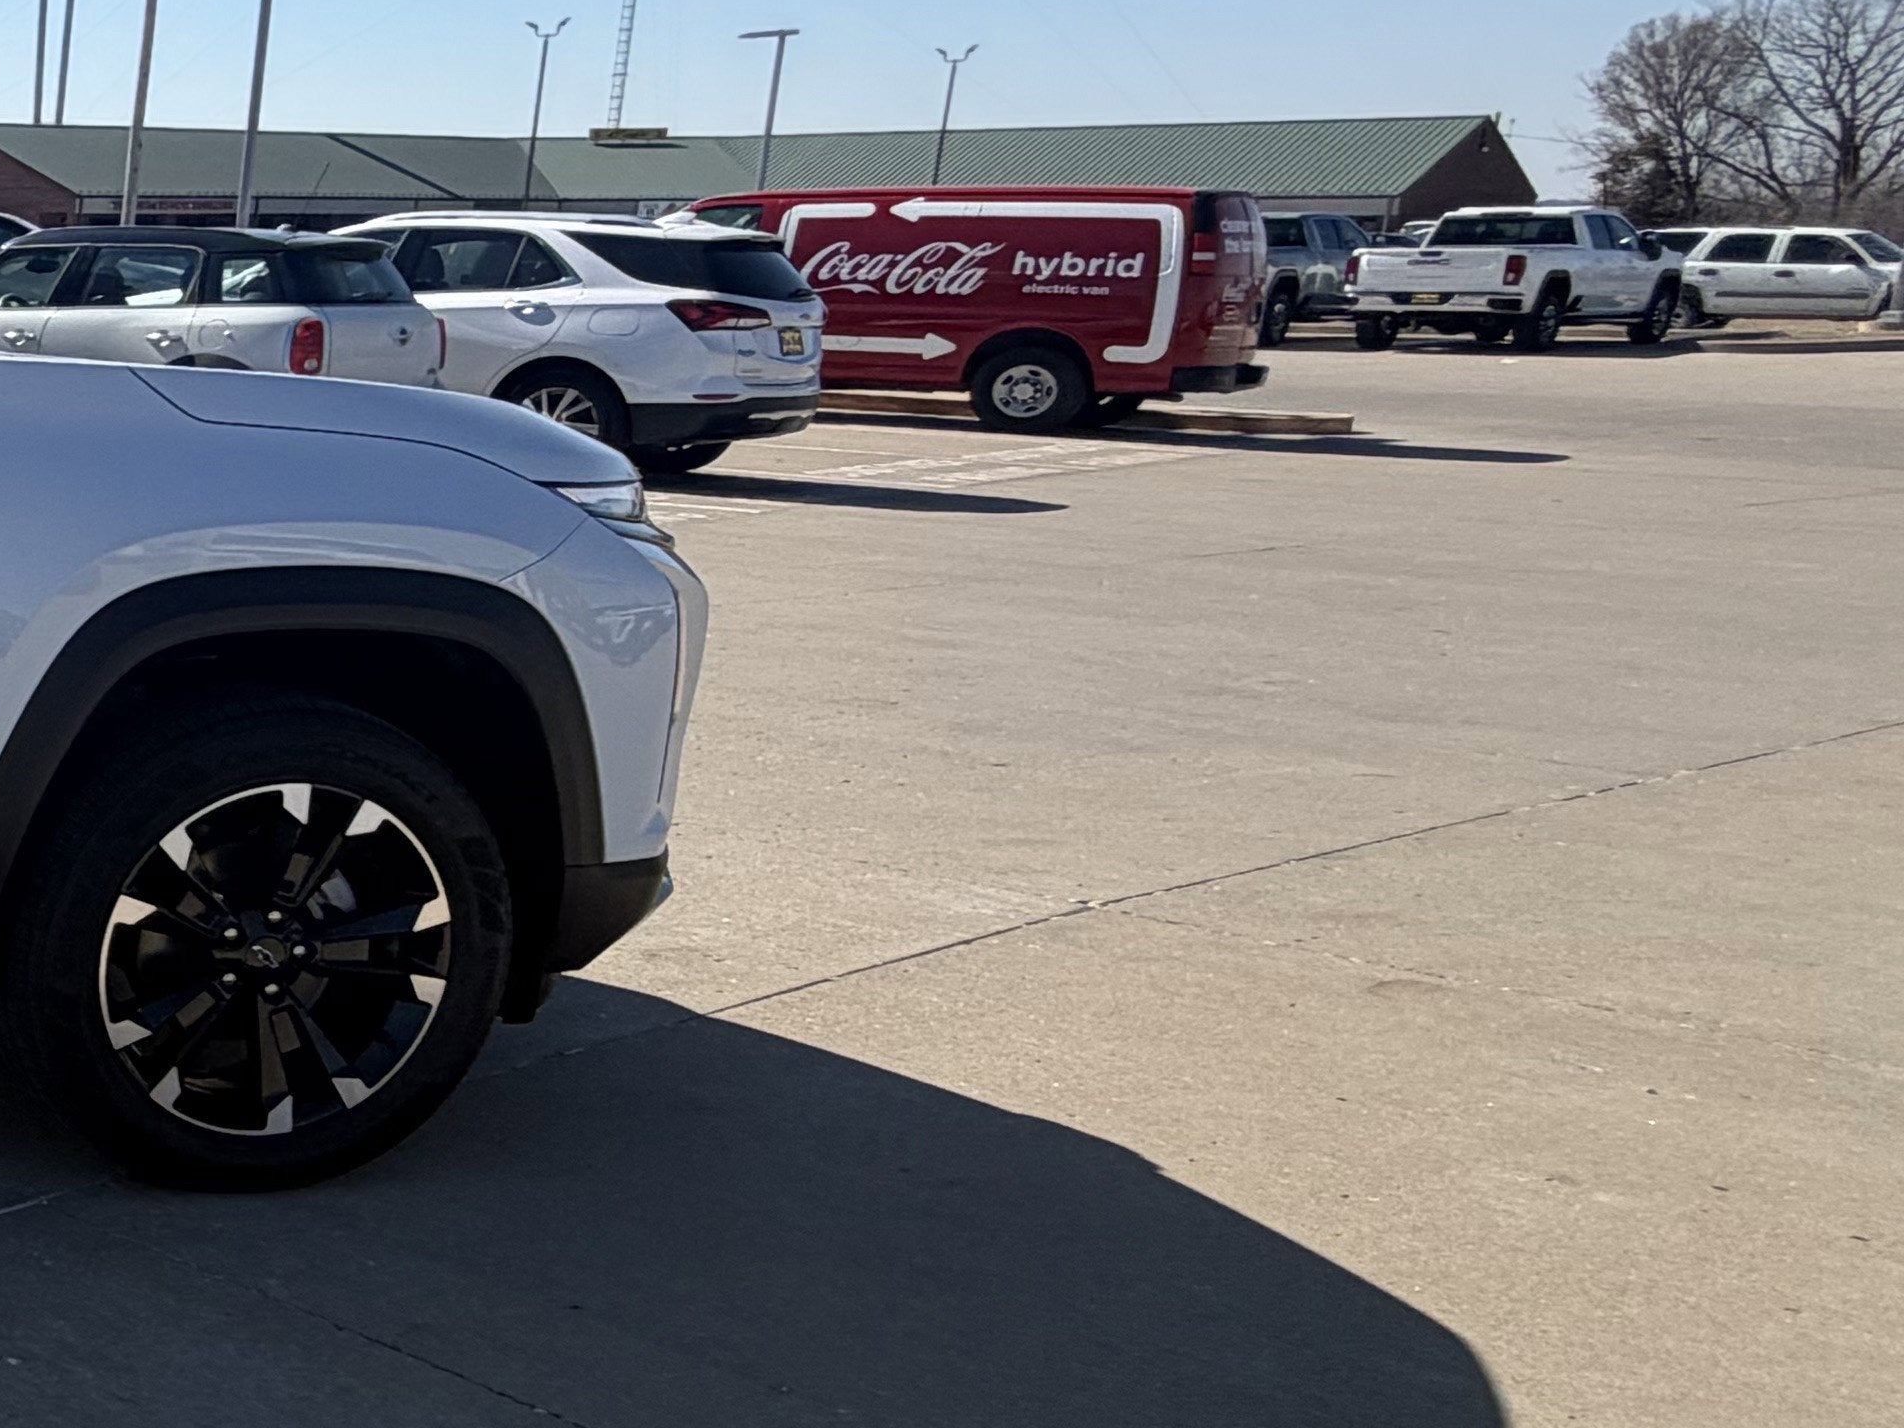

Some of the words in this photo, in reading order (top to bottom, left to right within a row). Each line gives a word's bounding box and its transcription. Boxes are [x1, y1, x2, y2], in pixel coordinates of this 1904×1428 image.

[801, 241, 1006, 296] Coca-Cola
[1012, 250, 1145, 281] hybrid
[1021, 283, 1079, 296] electric
[1081, 284, 1110, 296] van
